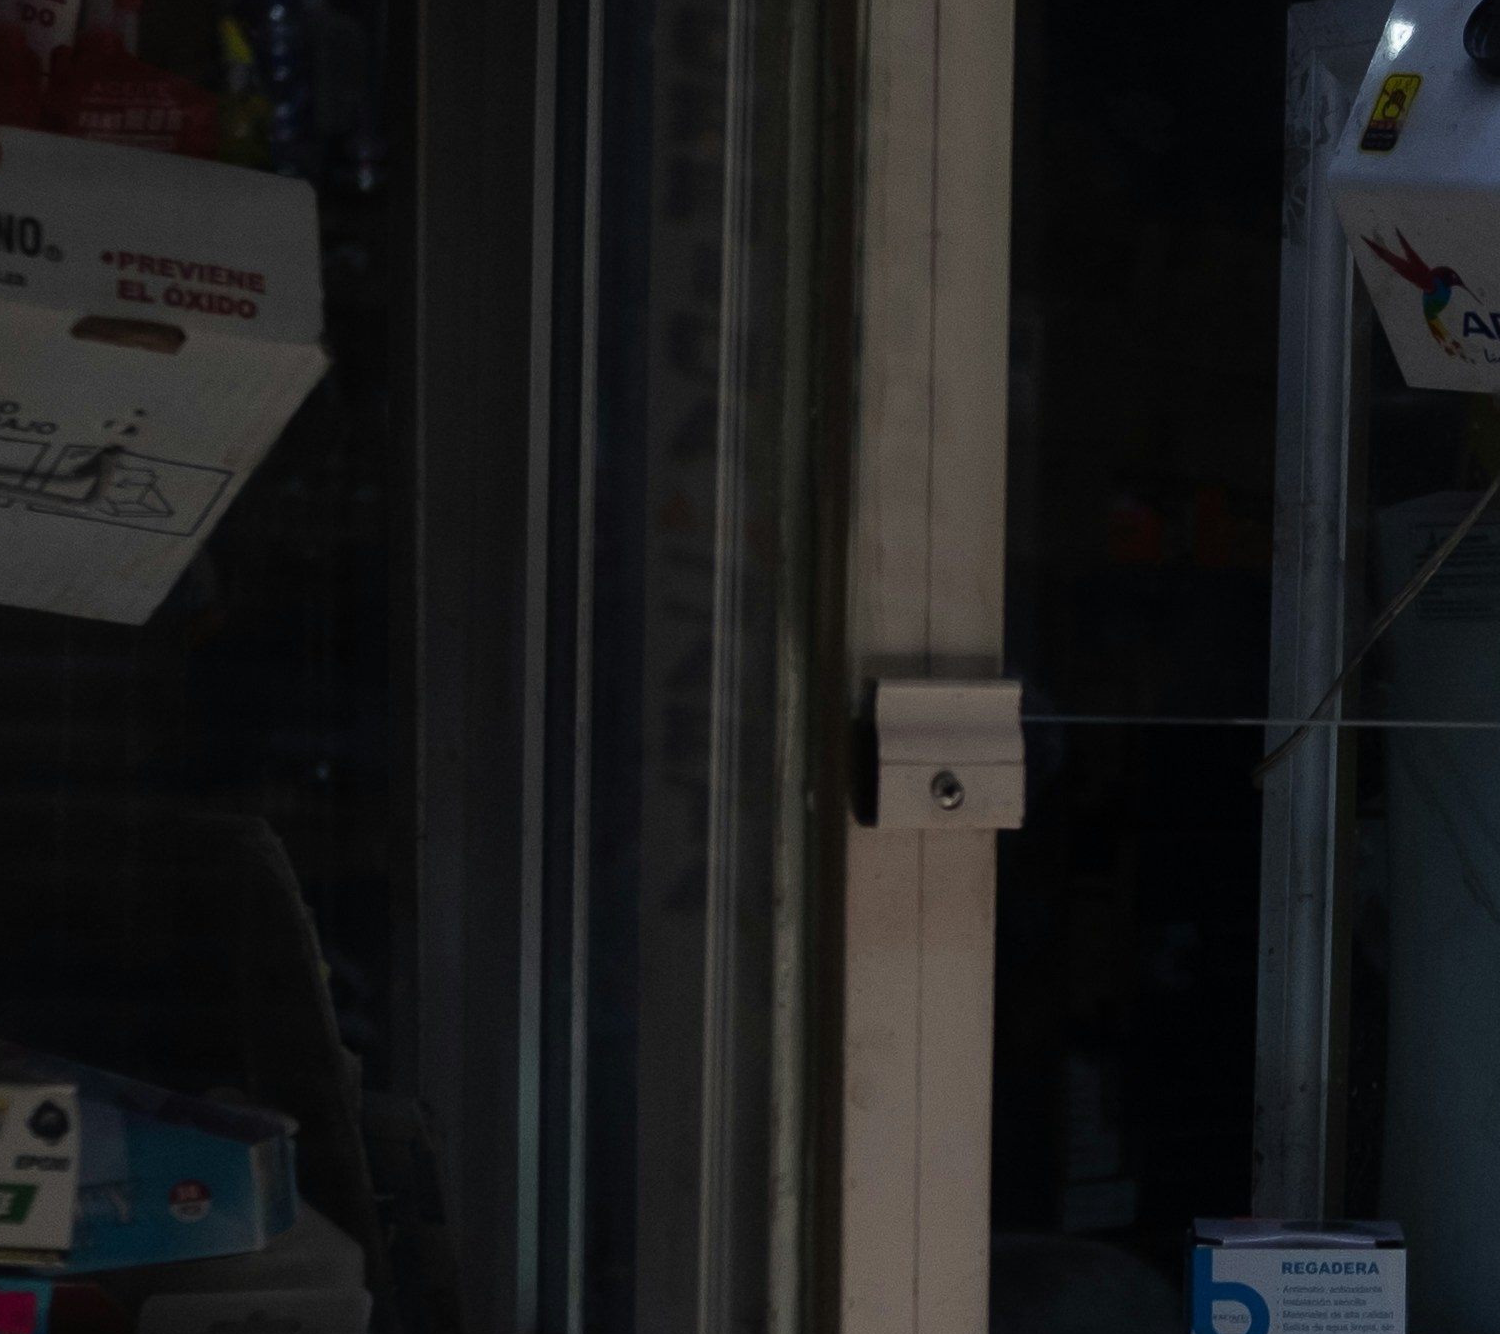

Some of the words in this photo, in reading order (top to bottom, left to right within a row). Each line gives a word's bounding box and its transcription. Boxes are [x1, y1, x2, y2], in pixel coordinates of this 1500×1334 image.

[117, 251, 265, 293] PREVIENE
[117, 279, 154, 304] EL
[164, 283, 257, 319] ÓXIDO
[1281, 1261, 1380, 1275] REGADERA
